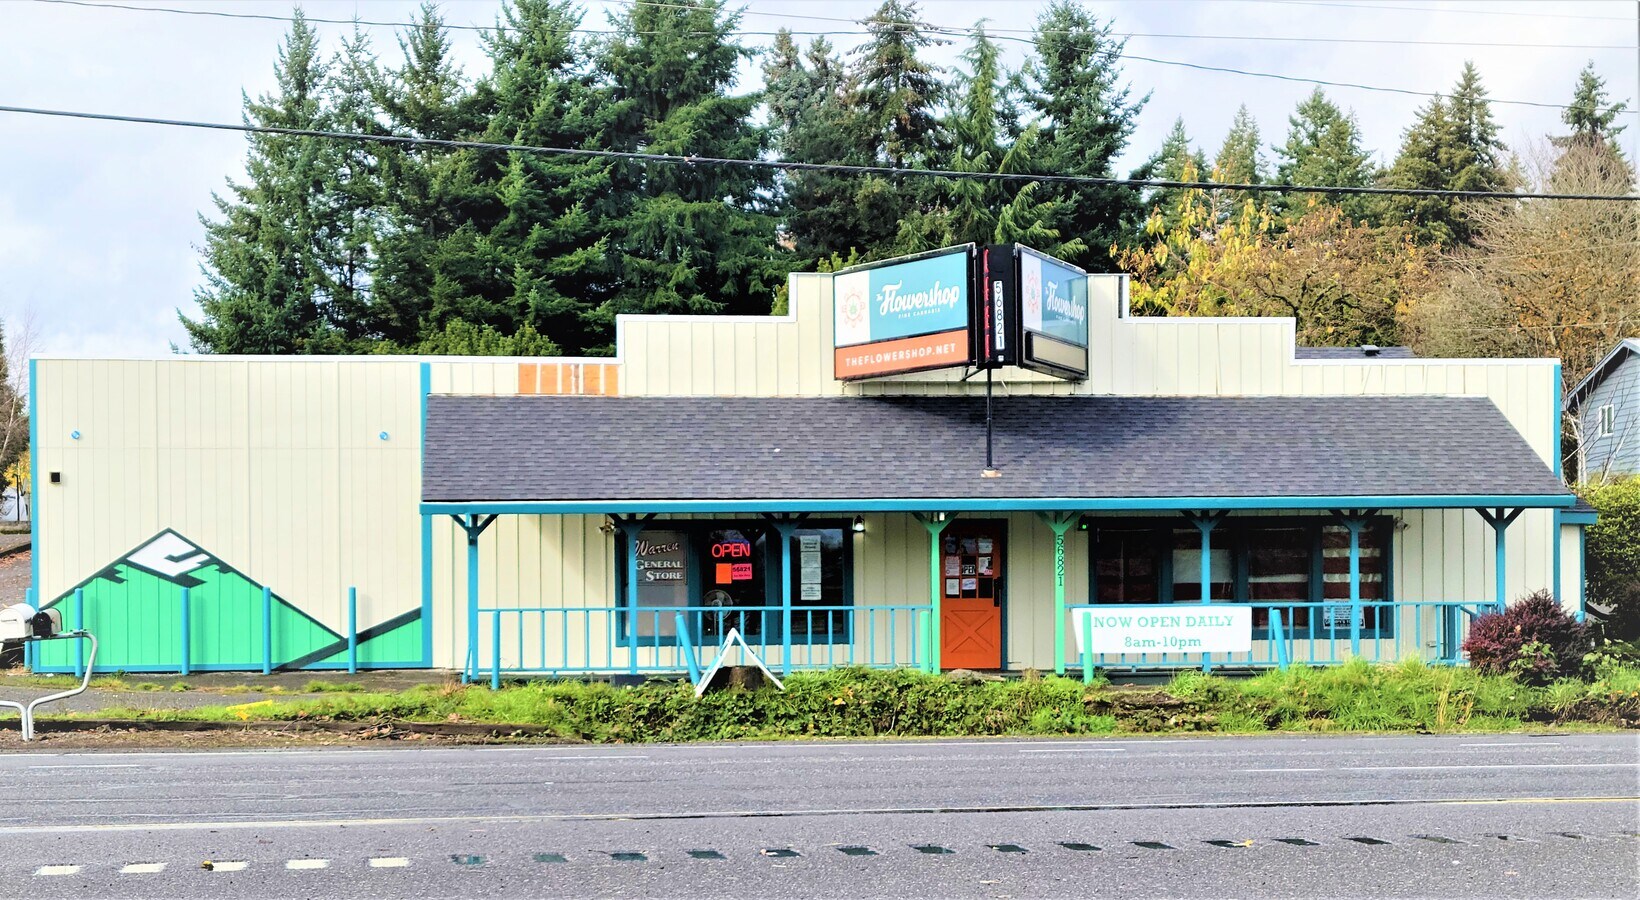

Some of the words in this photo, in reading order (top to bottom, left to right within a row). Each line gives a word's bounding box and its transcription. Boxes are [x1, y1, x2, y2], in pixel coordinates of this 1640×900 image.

[880, 280, 960, 315] Flowershop
[1046, 281, 1085, 325] Flowershop
[995, 282, 1004, 348] 56821
[845, 343, 957, 367] THEFLOWERSHOP.NET
[635, 540, 679, 557] Warren
[711, 543, 751, 558] OPEN
[635, 560, 683, 570] GENERAL
[645, 570, 683, 582] STORE
[1093, 616, 1132, 628] NOW
[1137, 616, 1181, 628] OPEN
[1186, 615, 1234, 627] DAILY
[1124, 636, 1202, 649] 8am-10pm
